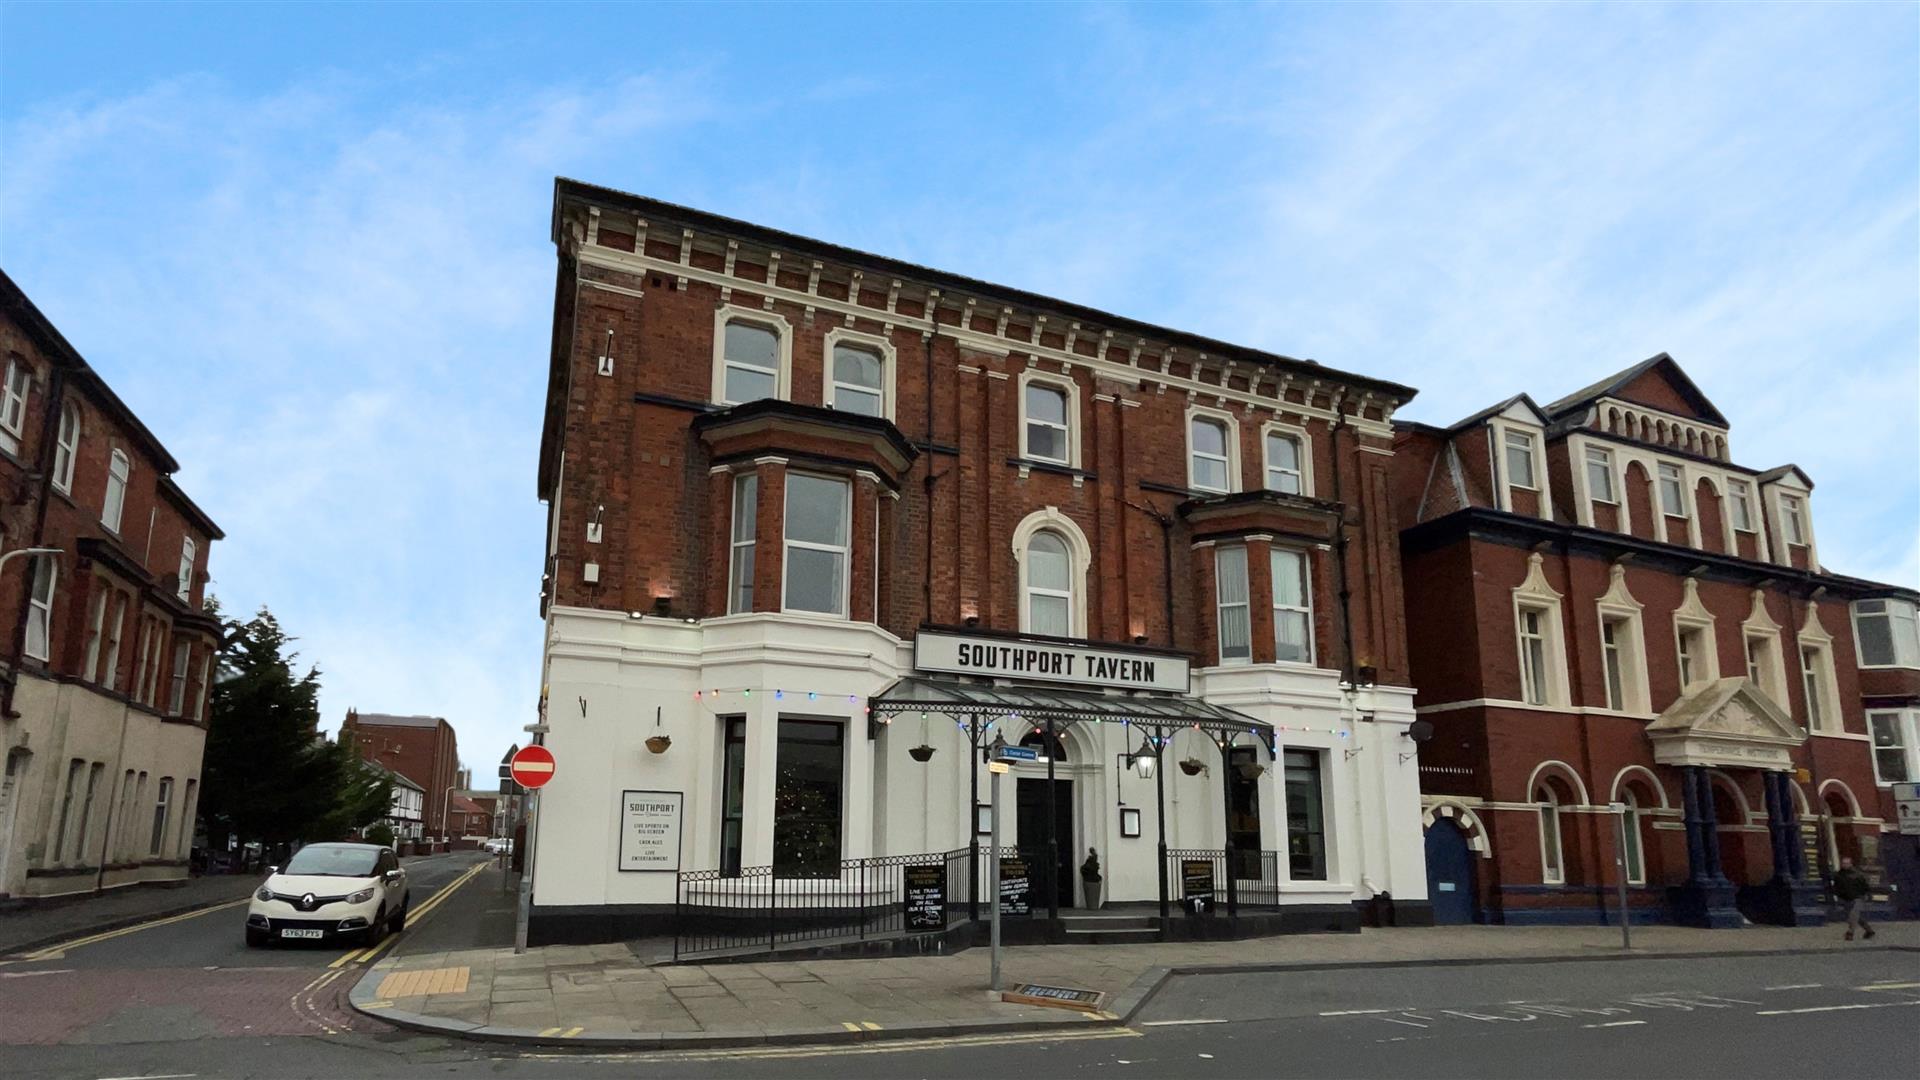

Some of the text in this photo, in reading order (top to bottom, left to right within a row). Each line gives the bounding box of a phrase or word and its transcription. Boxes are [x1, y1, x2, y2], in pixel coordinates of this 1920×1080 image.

[958, 643, 1155, 682] SOUTHPORT TAVERN
[629, 803, 675, 813] SOUTHPORT
